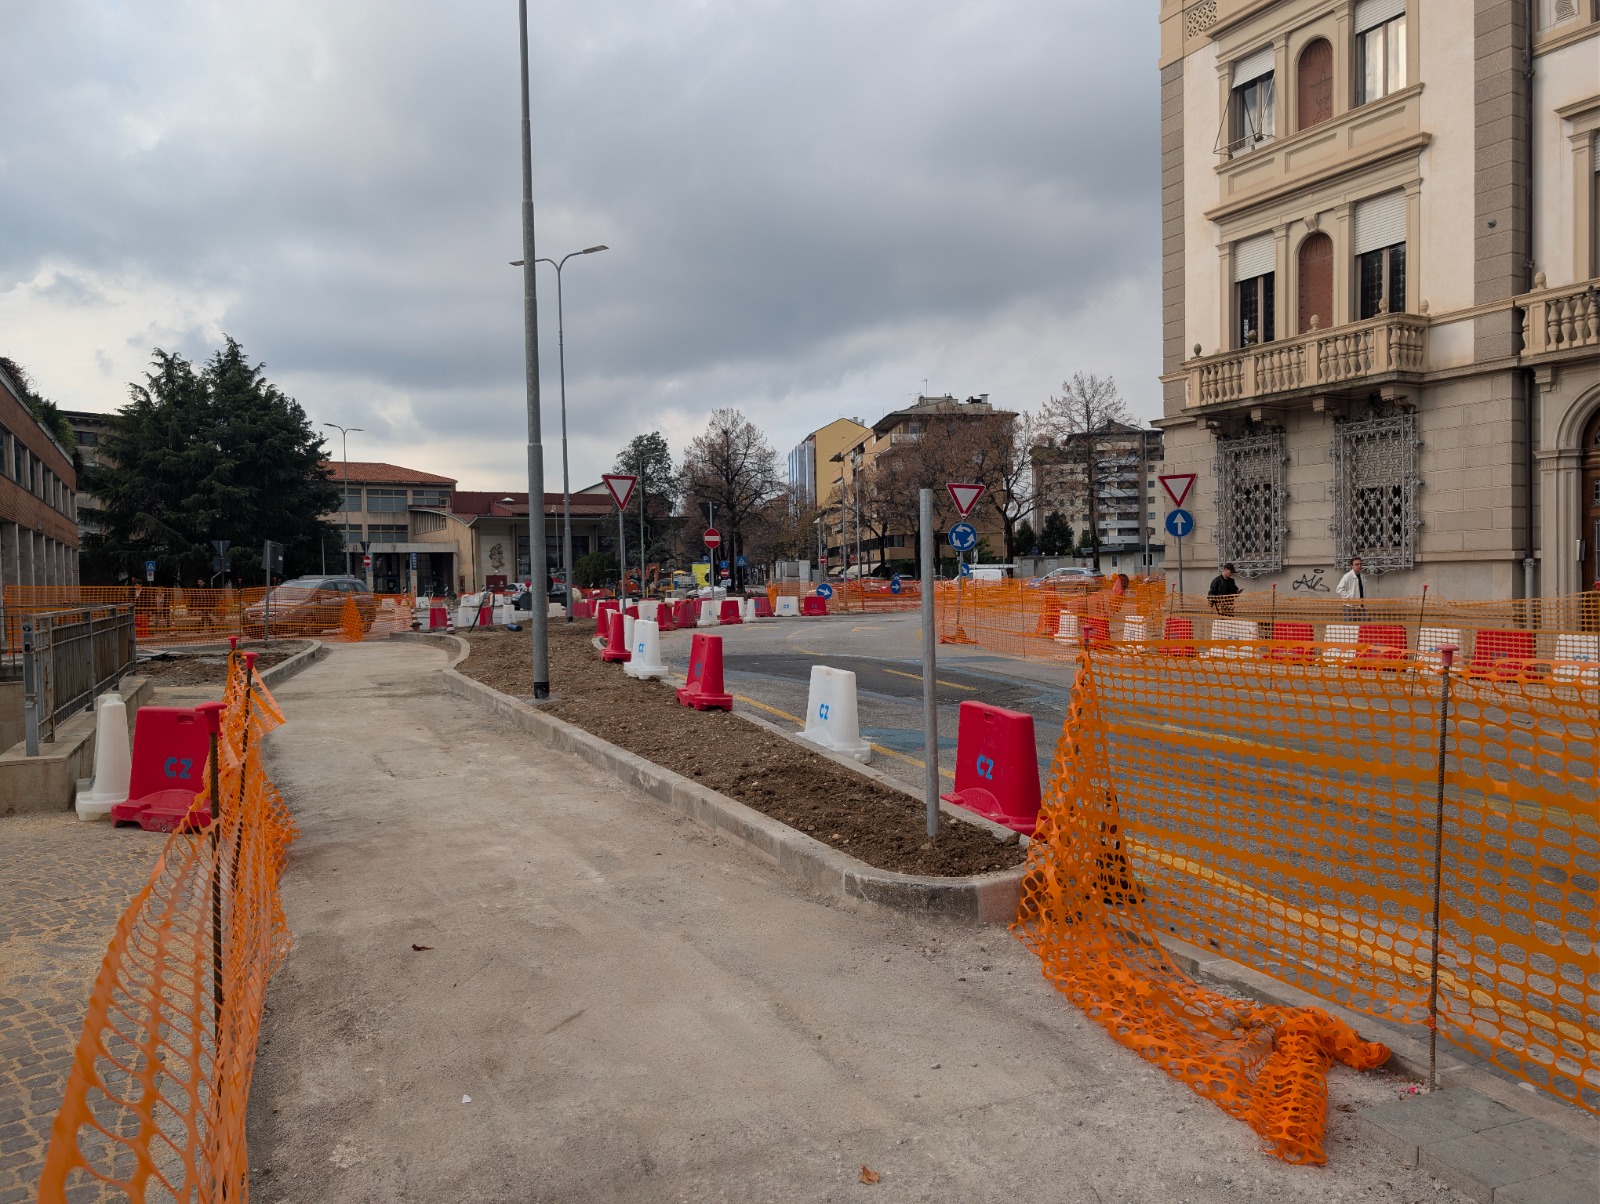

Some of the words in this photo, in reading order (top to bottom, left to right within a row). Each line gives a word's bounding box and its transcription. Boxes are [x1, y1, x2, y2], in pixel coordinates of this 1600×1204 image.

[819, 703, 829, 720] CZ
[164, 756, 192, 779] CZ
[976, 755, 994, 780] CZ
